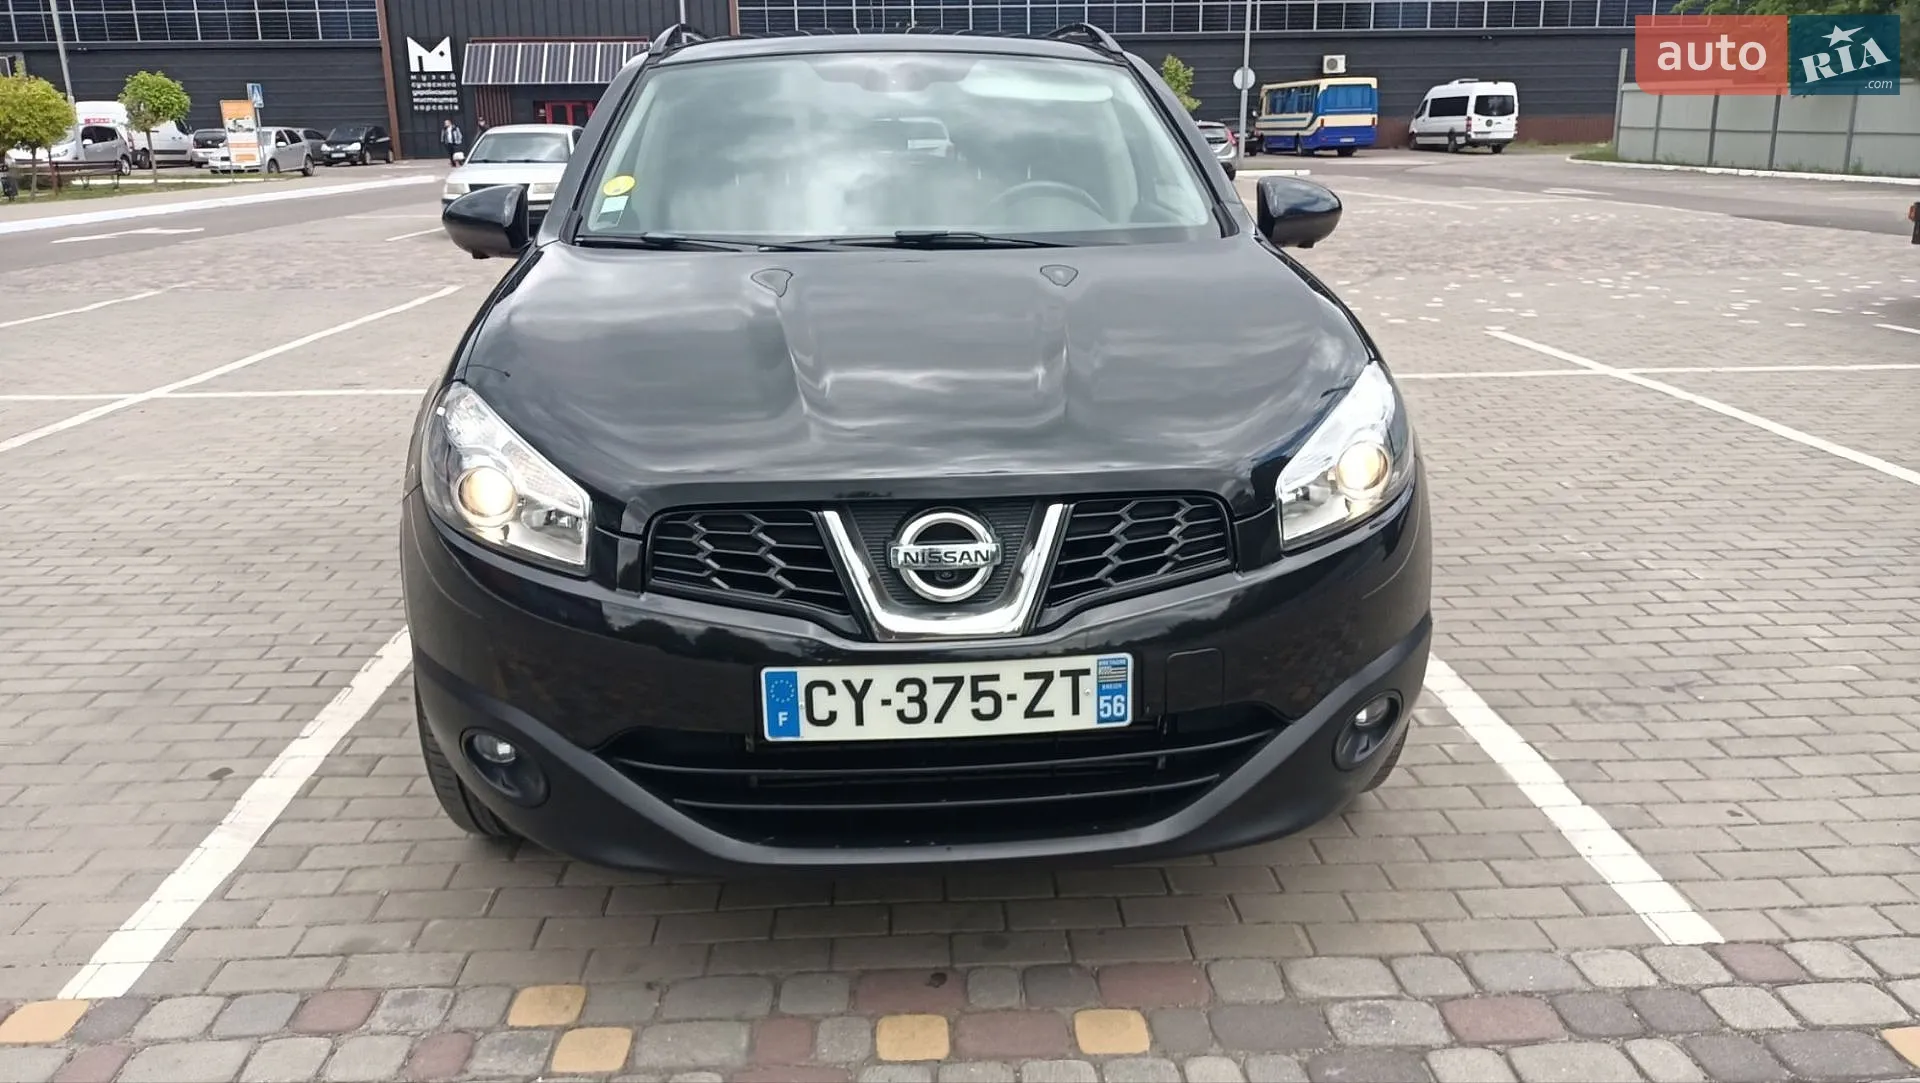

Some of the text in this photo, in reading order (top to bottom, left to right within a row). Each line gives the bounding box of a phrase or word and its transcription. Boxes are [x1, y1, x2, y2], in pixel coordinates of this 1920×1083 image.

[903, 549, 990, 564] NISSAN
[804, 668, 1091, 727] CY-375-ZT
[1099, 695, 1125, 718] 56
[777, 711, 789, 728] F
